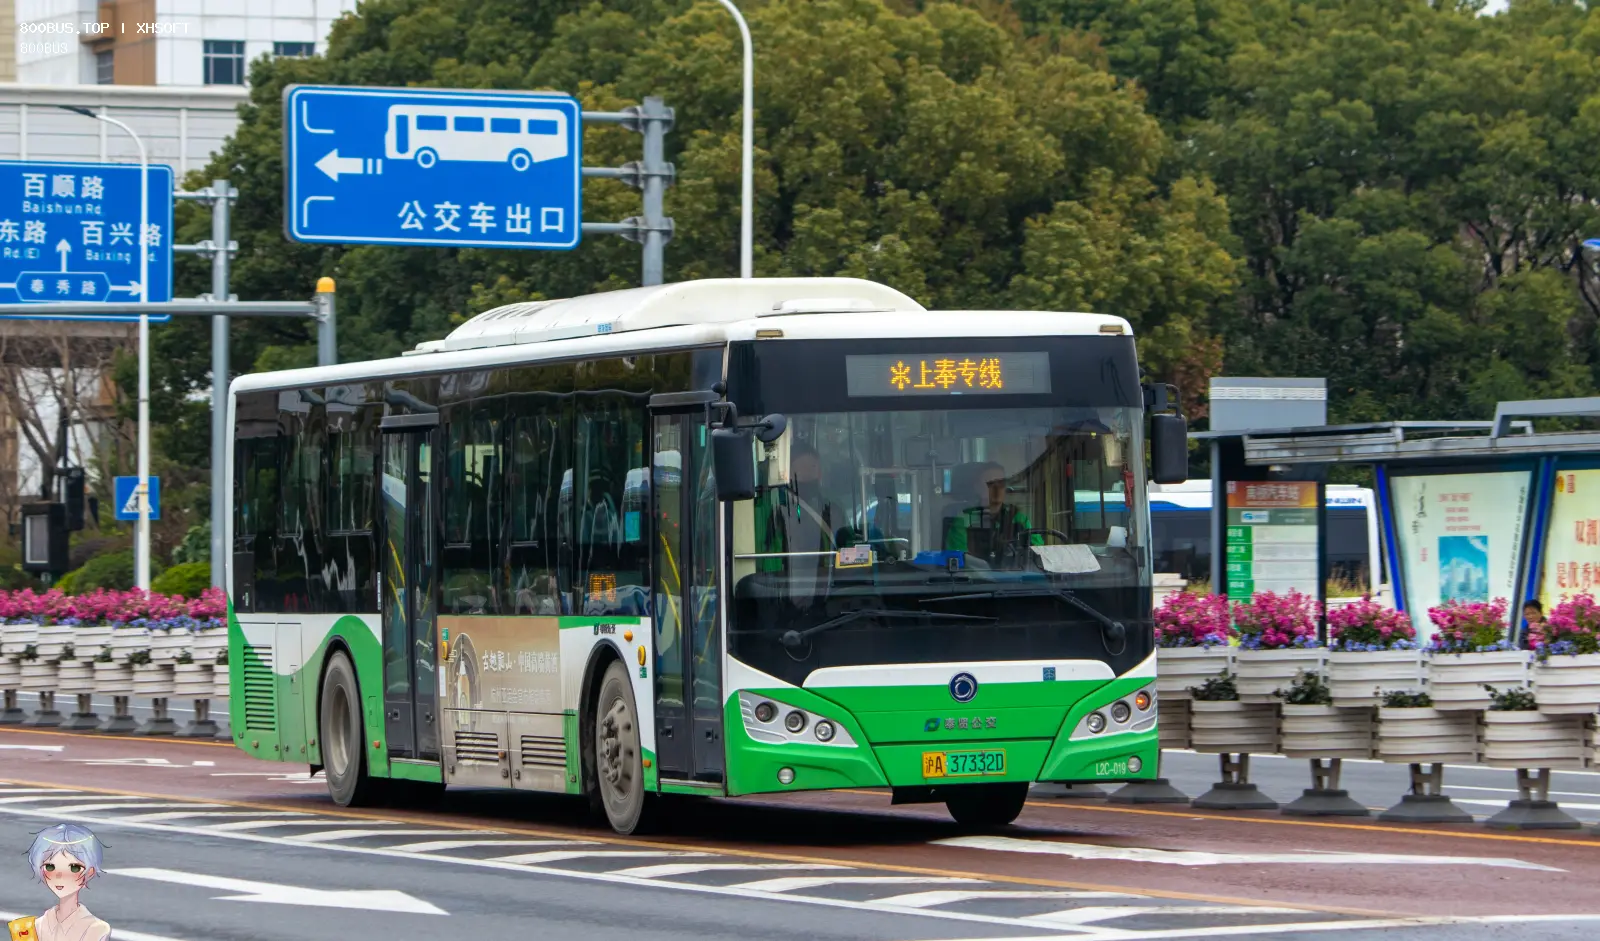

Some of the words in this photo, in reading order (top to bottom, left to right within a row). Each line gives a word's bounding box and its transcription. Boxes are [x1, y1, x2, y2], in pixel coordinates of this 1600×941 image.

[22, 173, 105, 199] 百顺路
[22, 200, 83, 215] Baishun
[398, 199, 565, 235] 公交车出口
[80, 221, 162, 247] 百兴路
[913, 358, 1003, 389] 上奉专线
[950, 753, 1004, 773] 37332D
[1095, 762, 1127, 776] L2C-019
